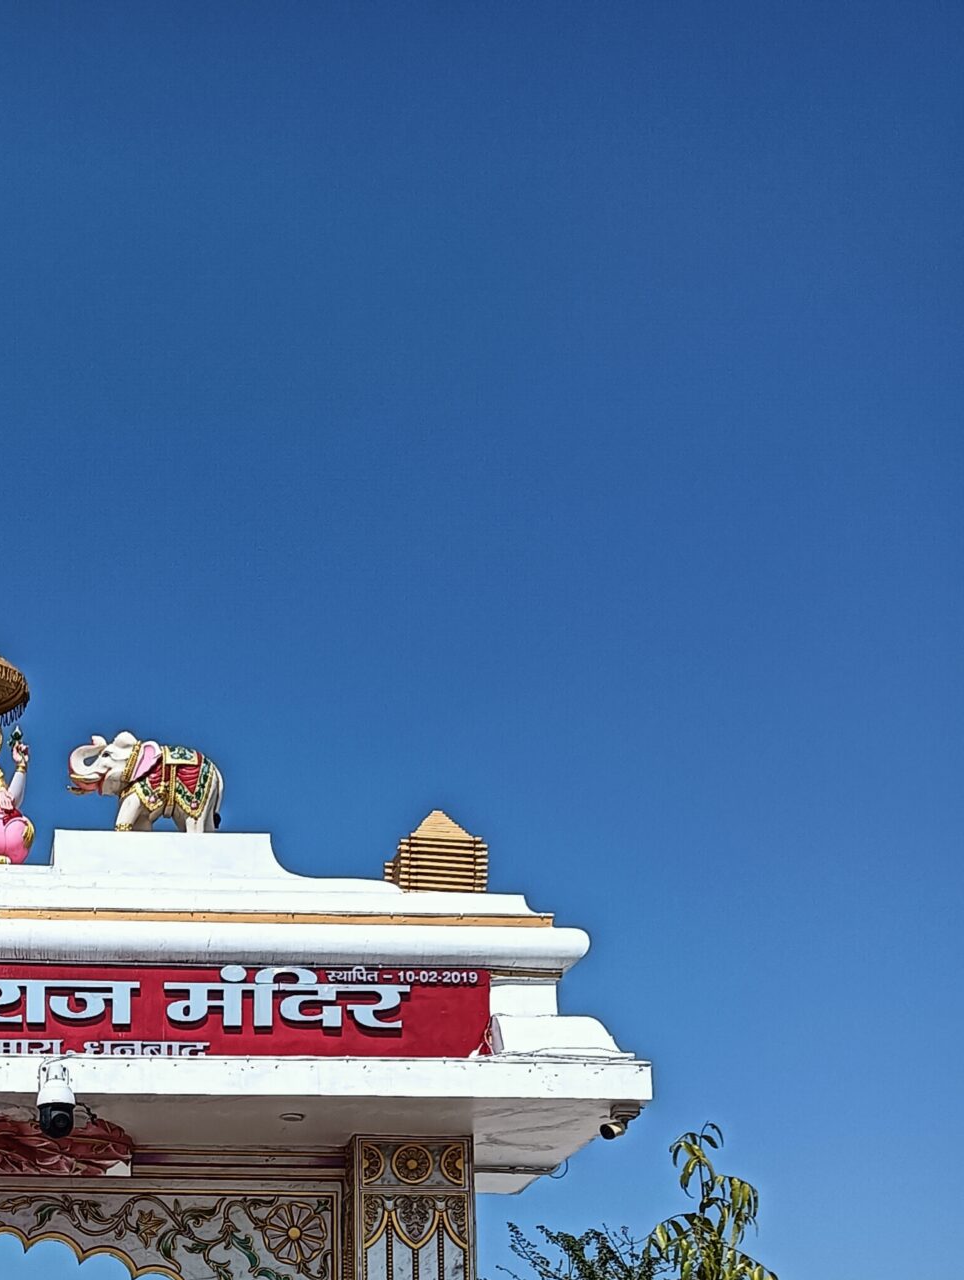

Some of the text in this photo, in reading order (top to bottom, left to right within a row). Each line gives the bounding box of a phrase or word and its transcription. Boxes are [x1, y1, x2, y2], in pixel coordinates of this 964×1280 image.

[326, 966, 378, 982] स्थापित
[398, 971, 478, 983] 10-02-2019
[164, 965, 411, 1028] मंदिर
